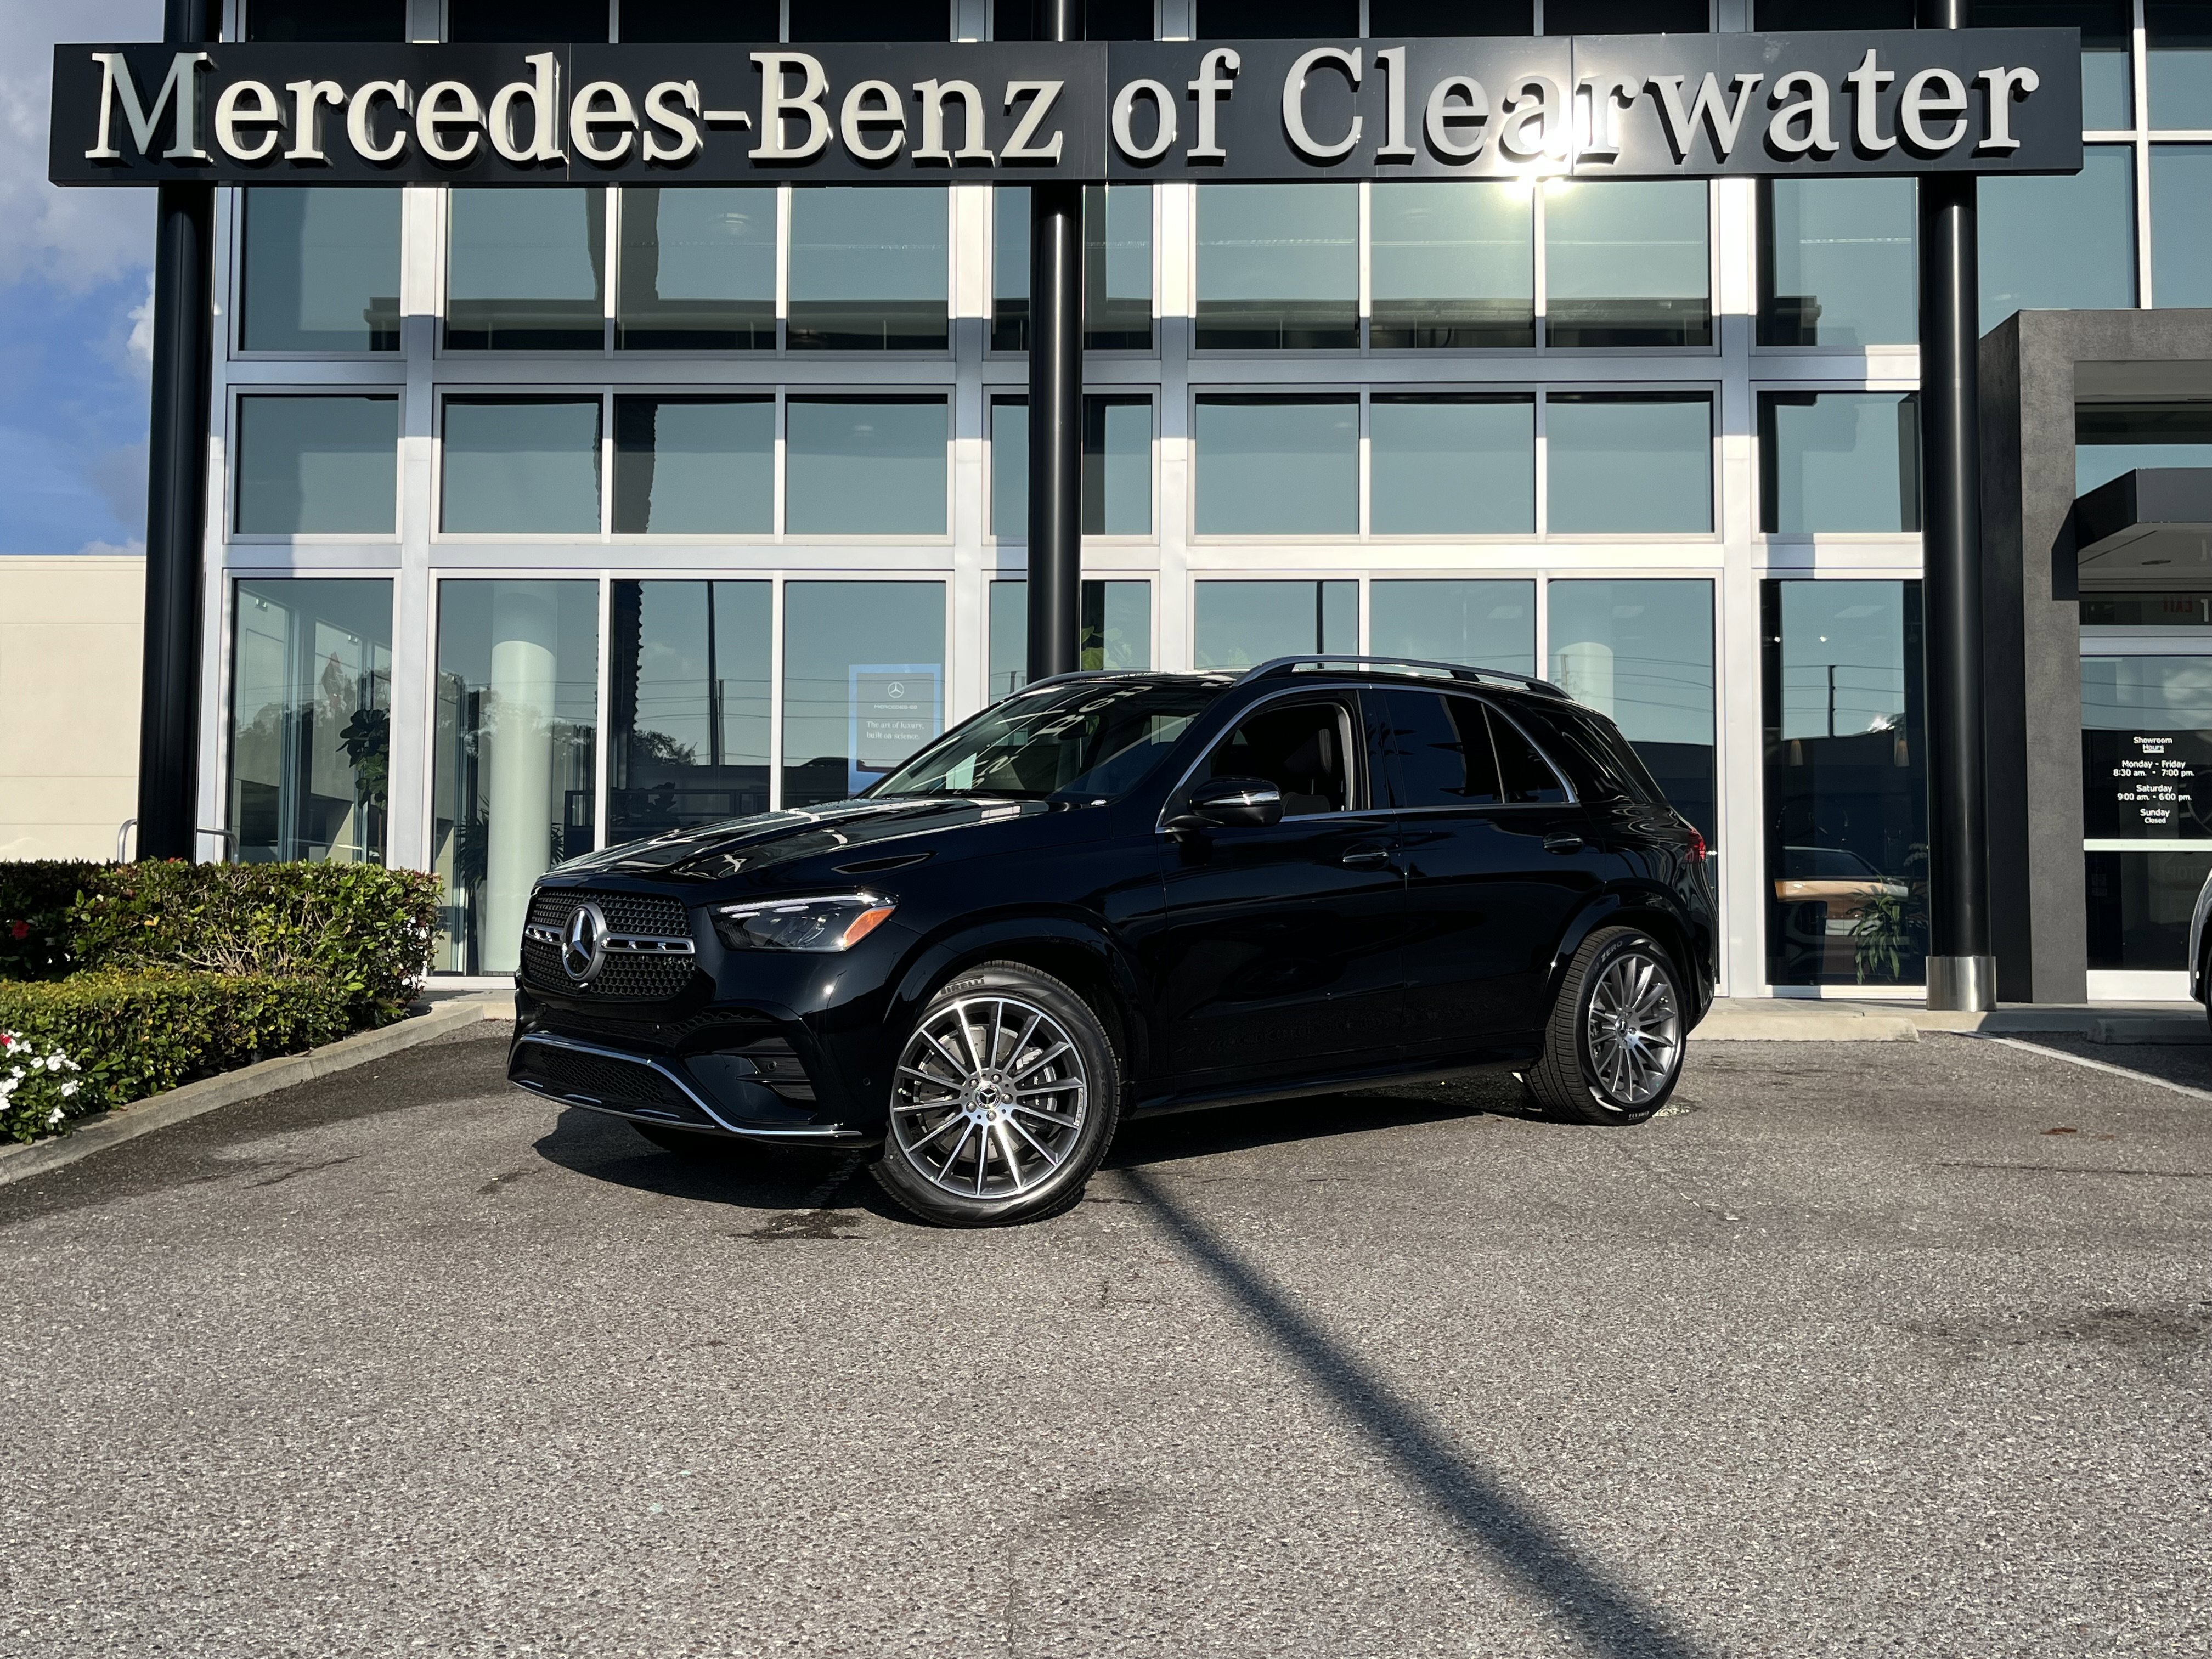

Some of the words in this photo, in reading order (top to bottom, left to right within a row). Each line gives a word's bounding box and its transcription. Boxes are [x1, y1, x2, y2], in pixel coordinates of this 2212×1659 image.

[84, 50, 1064, 165] Mercedes-Benz
[1111, 47, 1240, 161] of
[1282, 45, 2040, 160] Clearwater
[900, 721, 924, 730] luxury,
[2142, 744, 2164, 753] Hours
[2121, 760, 2153, 769] Monday
[2161, 760, 2186, 769] Friday
[2181, 770, 2194, 778] pm.
[2136, 784, 2172, 793] Saturday
[2117, 793, 2135, 801] 9:00
[2159, 793, 2176, 801] 6:00
[2178, 794, 2192, 802] pm.
[2140, 808, 2170, 817] Sunday
[1601, 941, 1623, 963] ZERO
